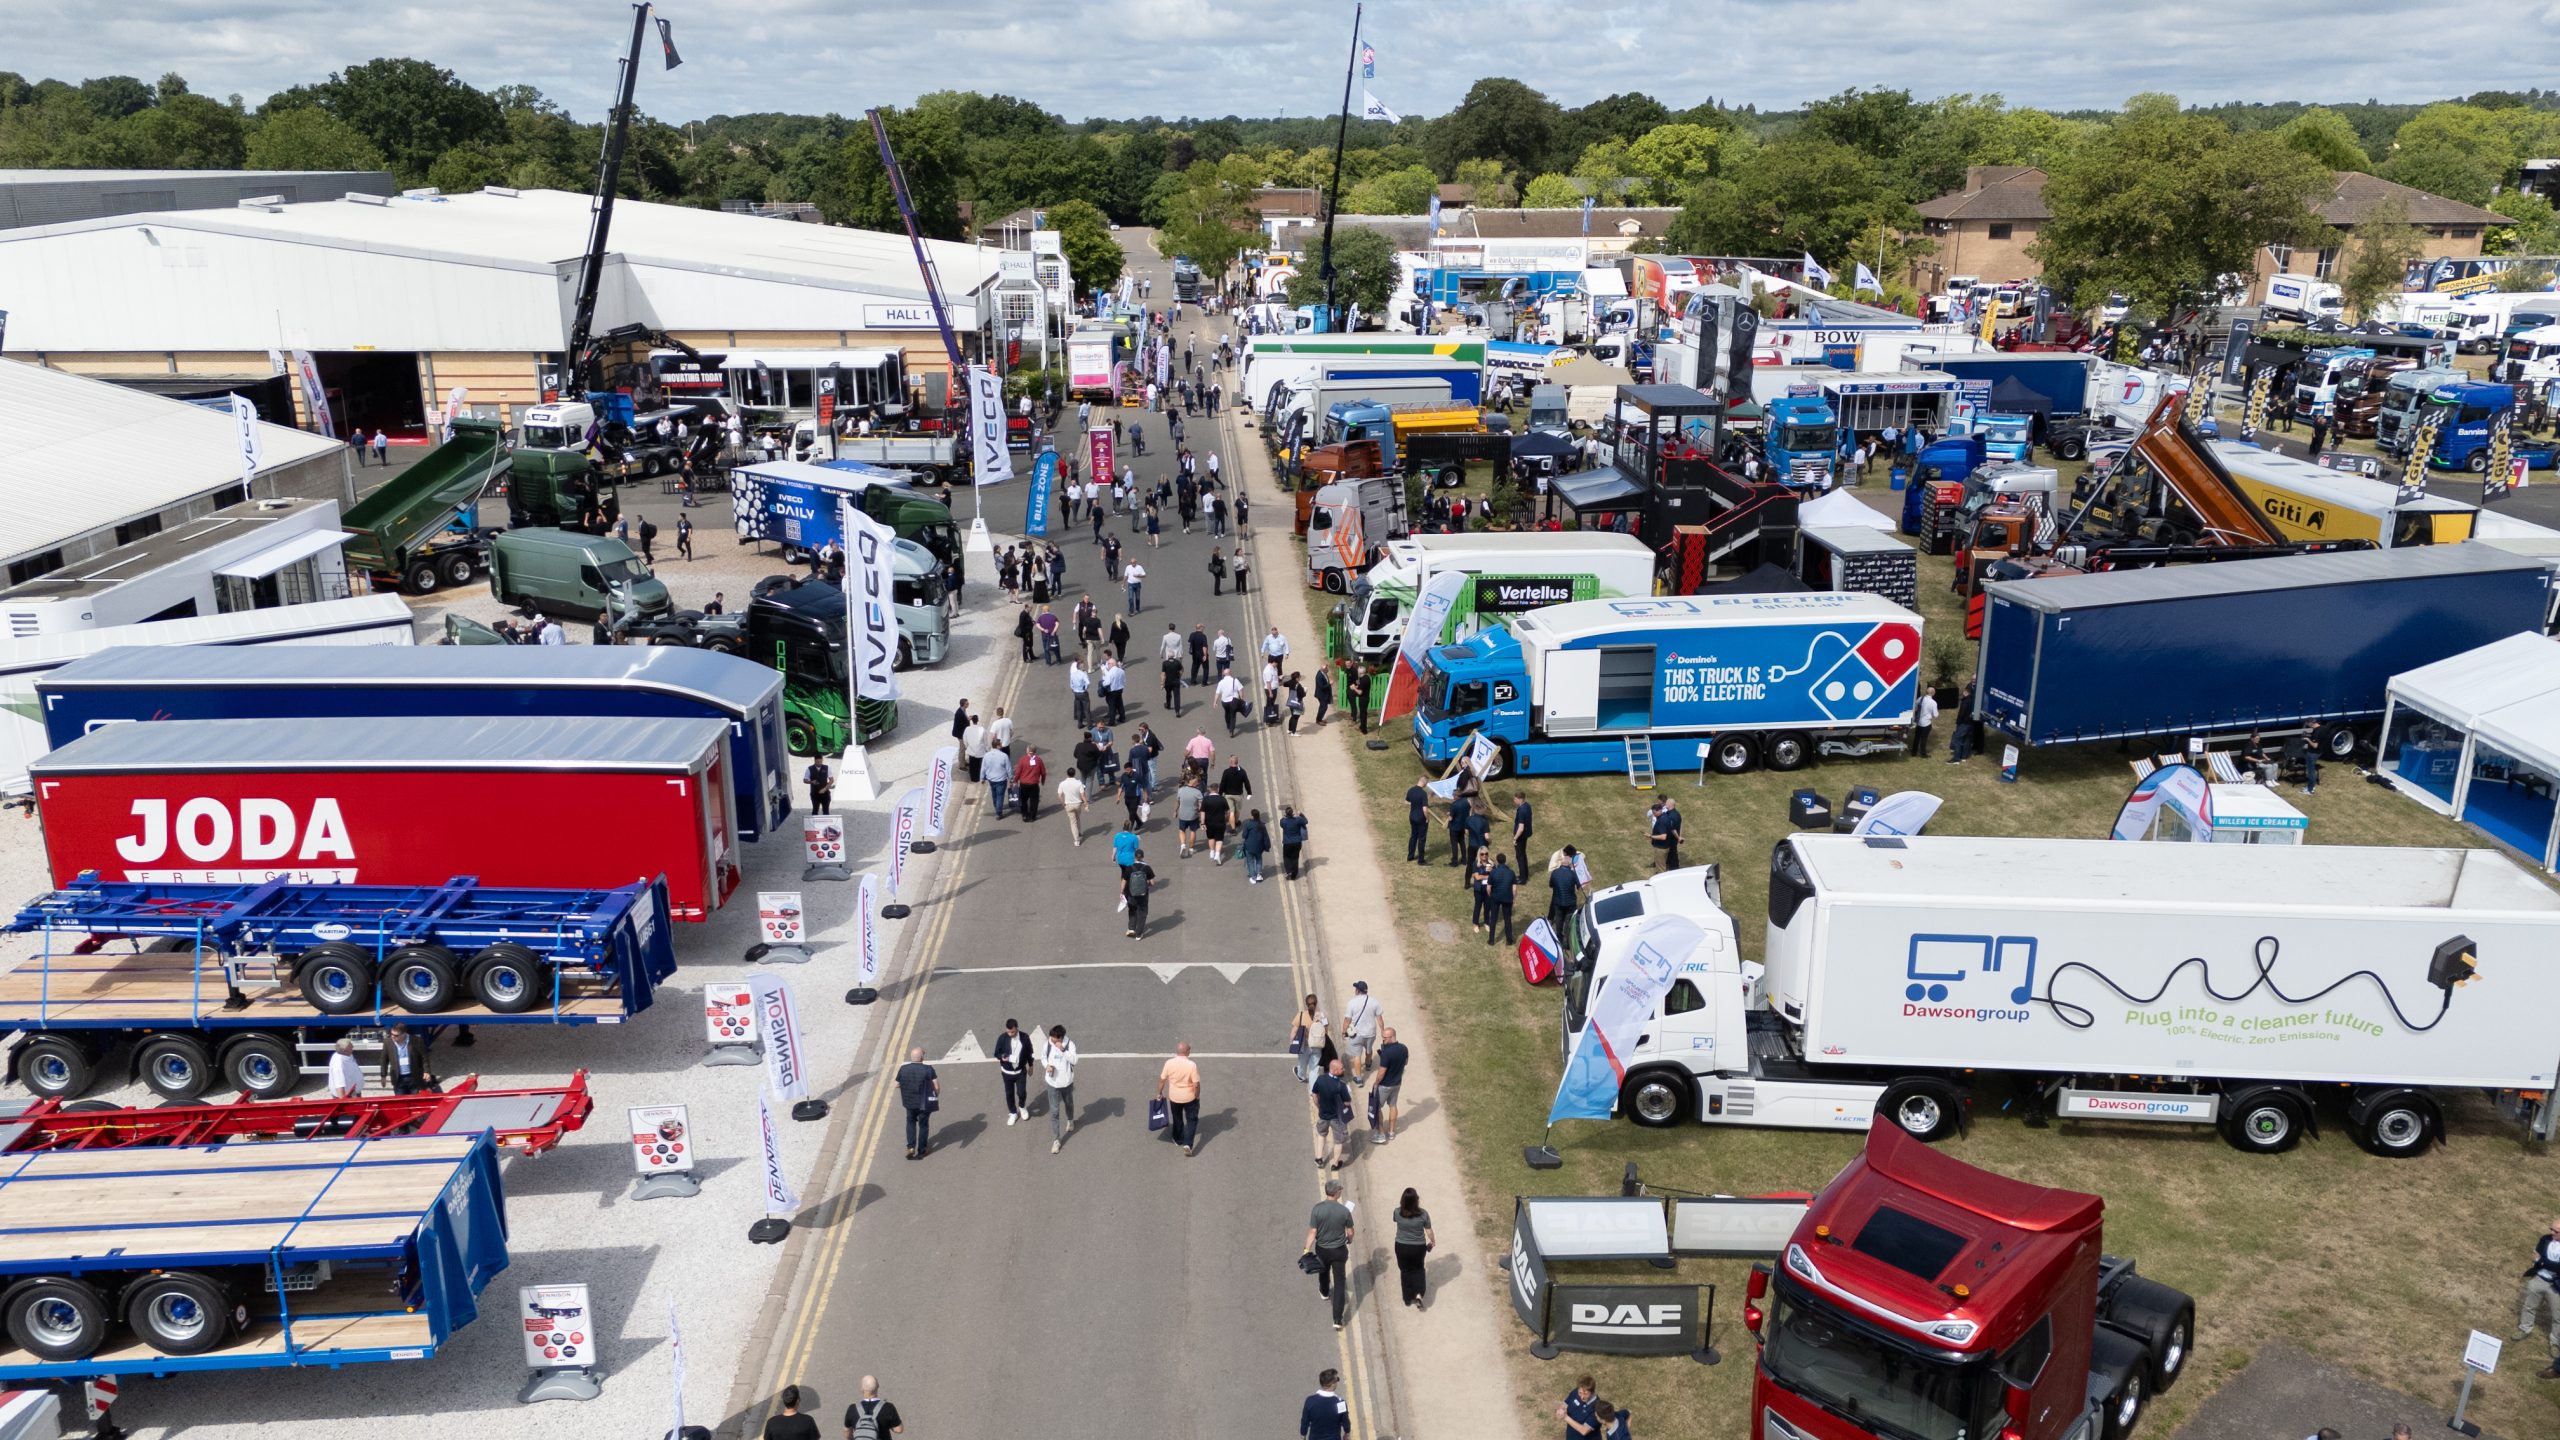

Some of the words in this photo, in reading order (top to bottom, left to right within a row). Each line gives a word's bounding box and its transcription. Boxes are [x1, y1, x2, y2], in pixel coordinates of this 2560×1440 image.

[887, 309, 921, 320] HALL
[925, 309, 930, 320] 1
[991, 291, 1000, 338] WELCOME
[1034, 291, 1043, 338] WELCOME
[1814, 331, 1860, 343] BOW
[701, 373, 723, 383] TODAY
[2251, 397, 2262, 424] Giti
[980, 379, 1002, 472] IVECO
[241, 404, 256, 471] VECO
[2365, 462, 2372, 471] 7
[2409, 448, 2425, 481] Giti
[2494, 450, 2507, 478] Giti
[1037, 463, 1050, 493] ZONE
[778, 494, 804, 504] IVECO
[1033, 493, 1046, 521] BLUE
[769, 503, 815, 520] eDAILY
[2265, 498, 2302, 523] Giti
[1499, 585, 1569, 600] Vertellus
[1712, 594, 1864, 606] ELECTRIC
[858, 529, 889, 684] IVECO
[1677, 655, 1718, 664] Domino's
[1664, 668, 1695, 686] THIS
[1698, 666, 1744, 685] TRUCK
[1746, 666, 1761, 683] IS
[1663, 686, 1699, 703] 100%
[1703, 683, 1766, 702] ELECTRIC
[933, 759, 947, 829] DENNISON
[115, 796, 356, 863] JODA
[2218, 817, 2246, 825] WILLEN
[2247, 817, 2260, 825] ICE
[2262, 818, 2288, 826] CREAM
[141, 870, 341, 883] FREIGHT
[1680, 962, 1709, 972] TRIC
[1903, 1002, 2030, 1023] Dawsongroup
[2125, 1008, 2172, 1027] Plug
[2178, 1006, 2218, 1025] into
[2222, 1016, 2236, 1028] a
[2241, 1009, 2320, 1032] cleaner
[2324, 1008, 2385, 1037] future
[2165, 1024, 2197, 1038] 100%
[2199, 1026, 2246, 1045] Electric,
[2248, 1032, 2277, 1045] Zero
[2278, 1030, 2341, 1044] Emissions
[2087, 1097, 2189, 1116] Dawsongroup
[1834, 1115, 1870, 1123] ELECTRIC
[1513, 1227, 1537, 1299] DAF
[1571, 1304, 1682, 1325] DAF
